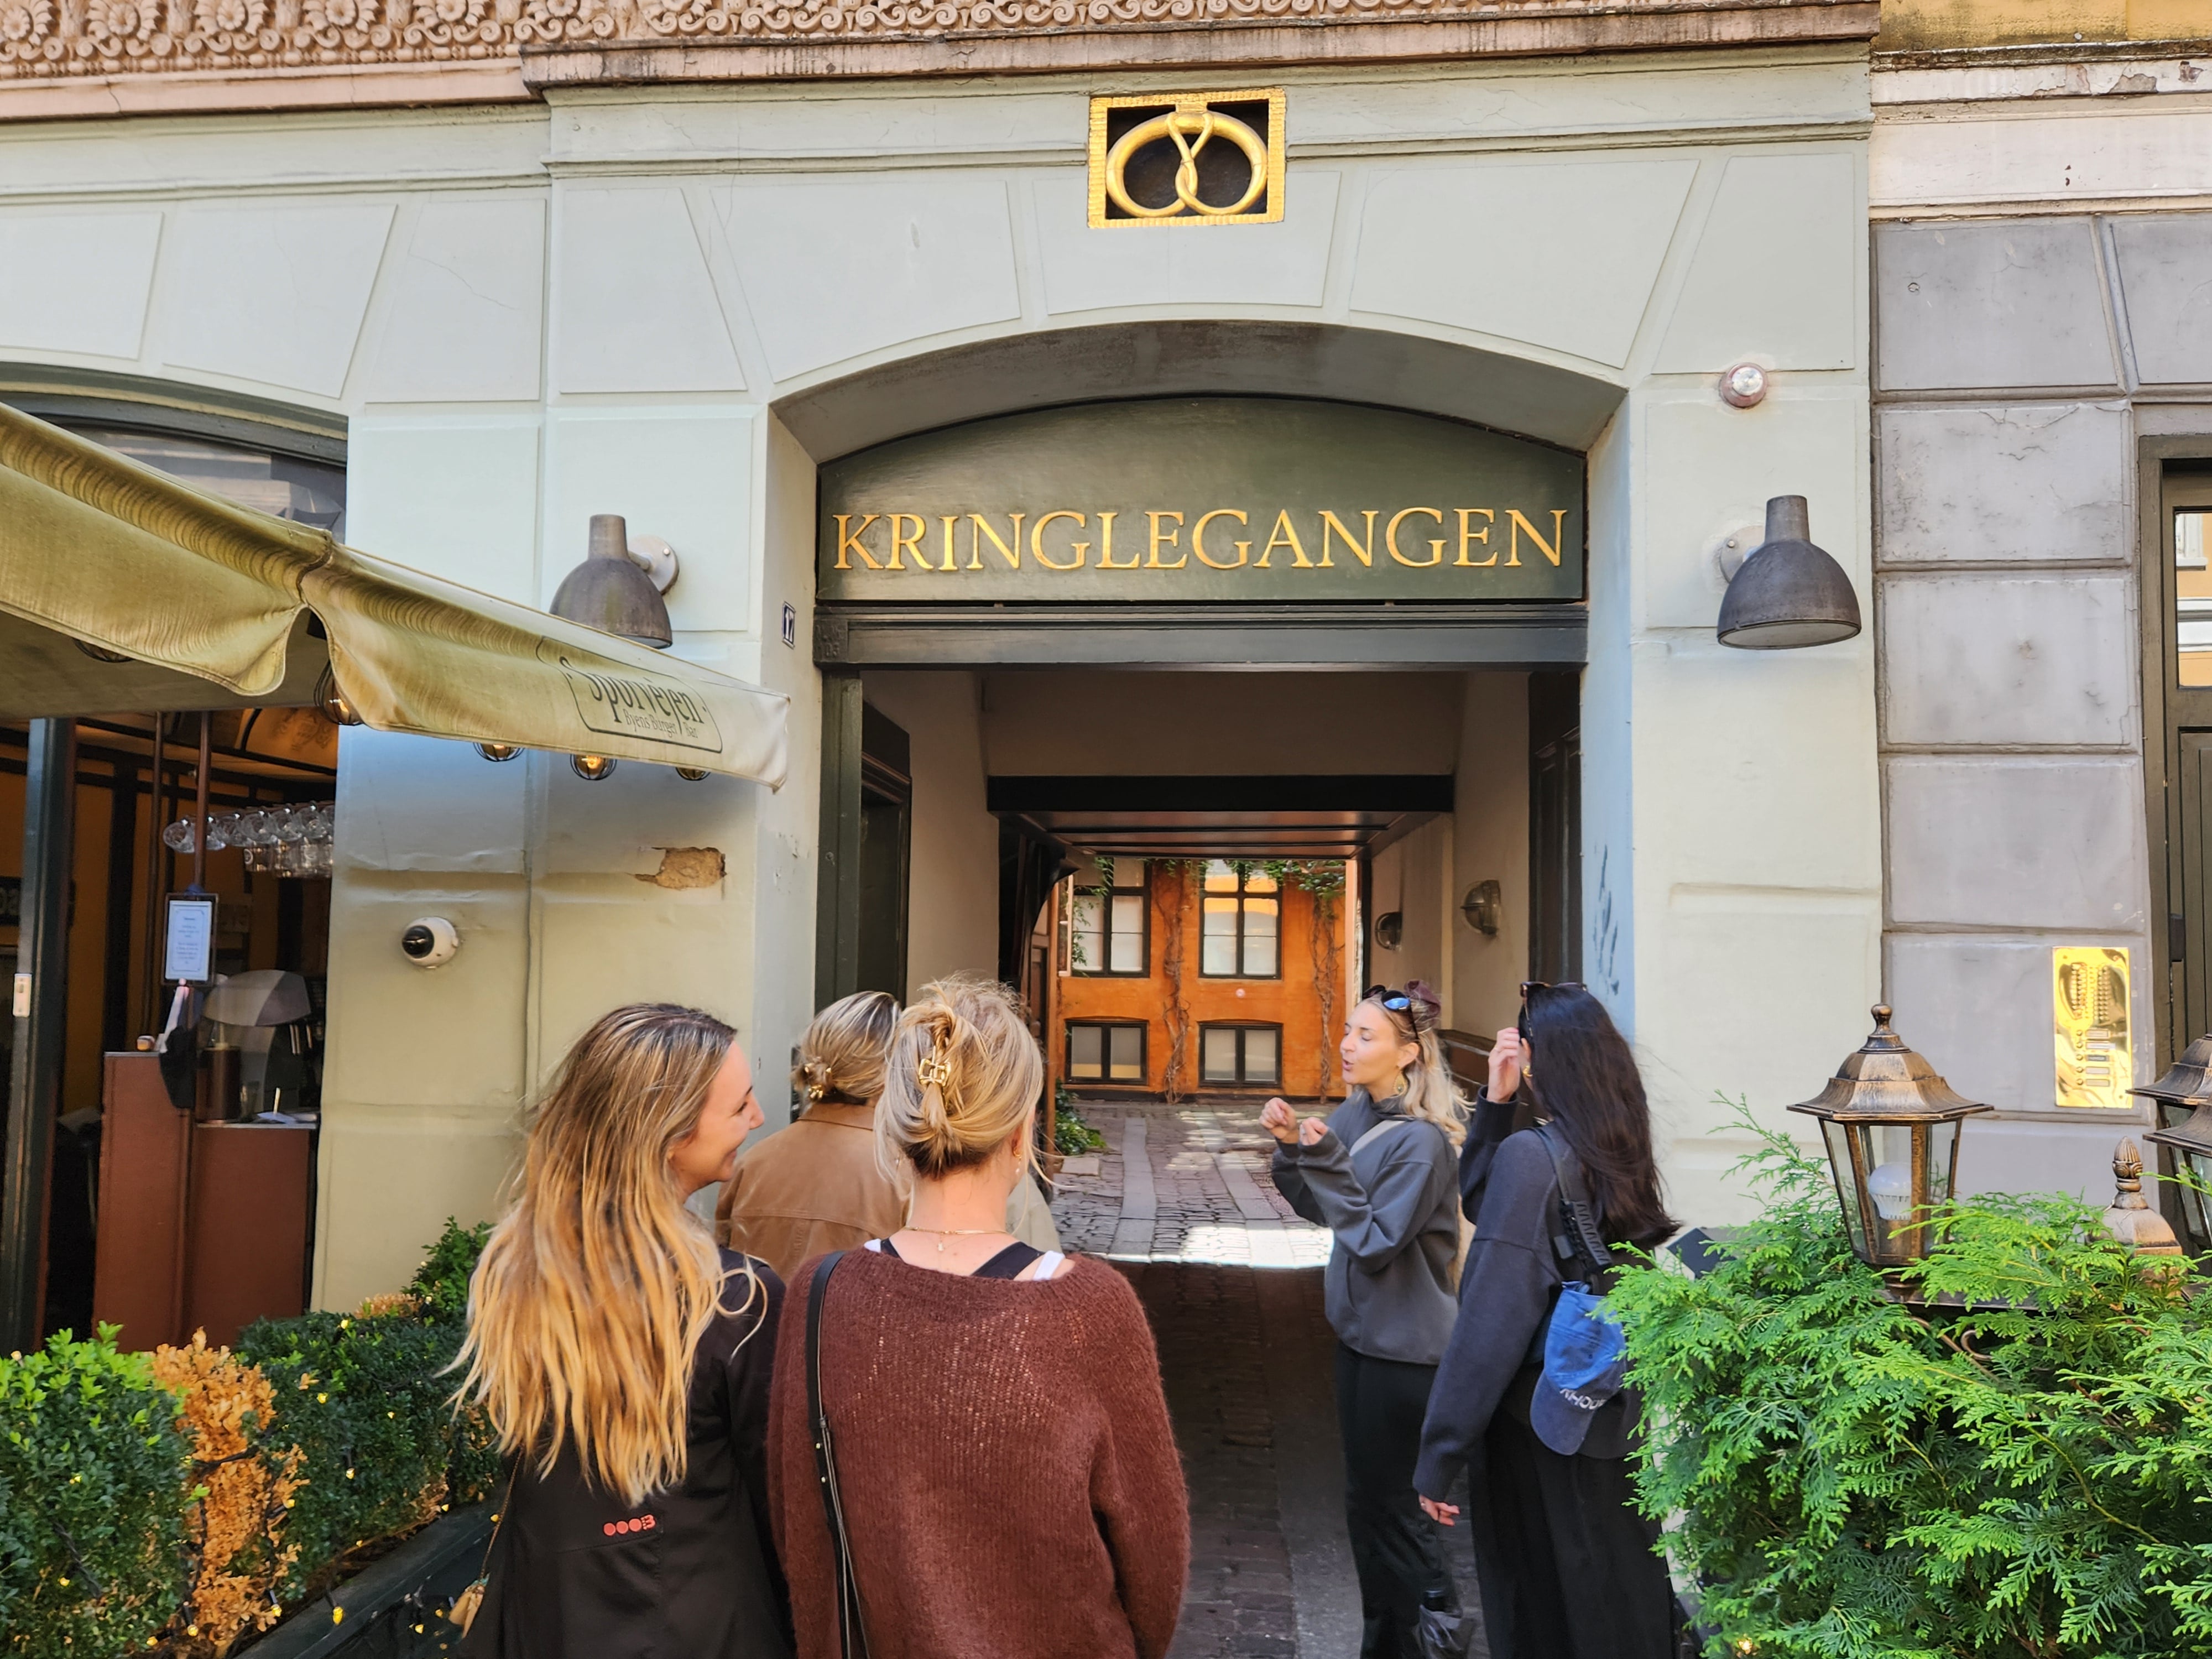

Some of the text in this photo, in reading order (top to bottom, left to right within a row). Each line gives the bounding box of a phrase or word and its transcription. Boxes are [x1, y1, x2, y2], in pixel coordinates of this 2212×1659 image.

[833, 507, 1566, 572] KRINGLEGANGEN
[785, 607, 794, 643] 17
[559, 656, 705, 734] Sporvejen
[623, 709, 698, 738] Byens Burger Bar
